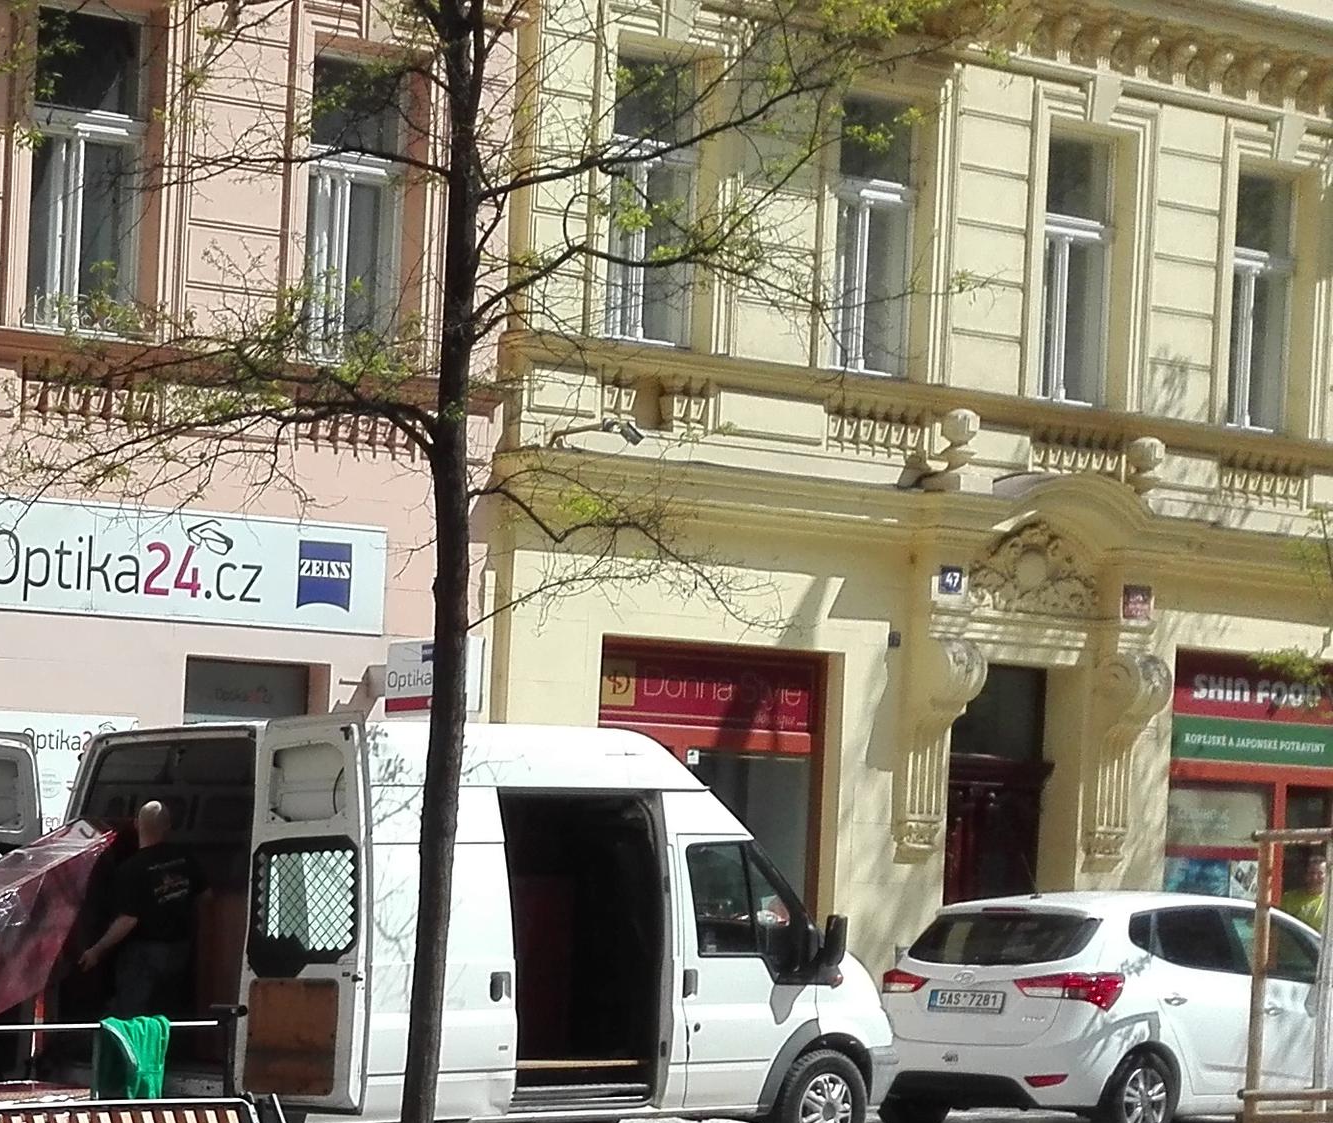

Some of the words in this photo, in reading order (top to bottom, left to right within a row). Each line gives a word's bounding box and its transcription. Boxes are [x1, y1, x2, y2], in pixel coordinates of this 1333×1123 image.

[299, 559, 351, 580] ZEISS
[945, 572, 960, 587] 47
[387, 668, 433, 691] Optika
[643, 667, 734, 701] Donna
[1228, 738, 1234, 747] A
[939, 991, 963, 1005] 5AS
[967, 992, 998, 1006] 7281
